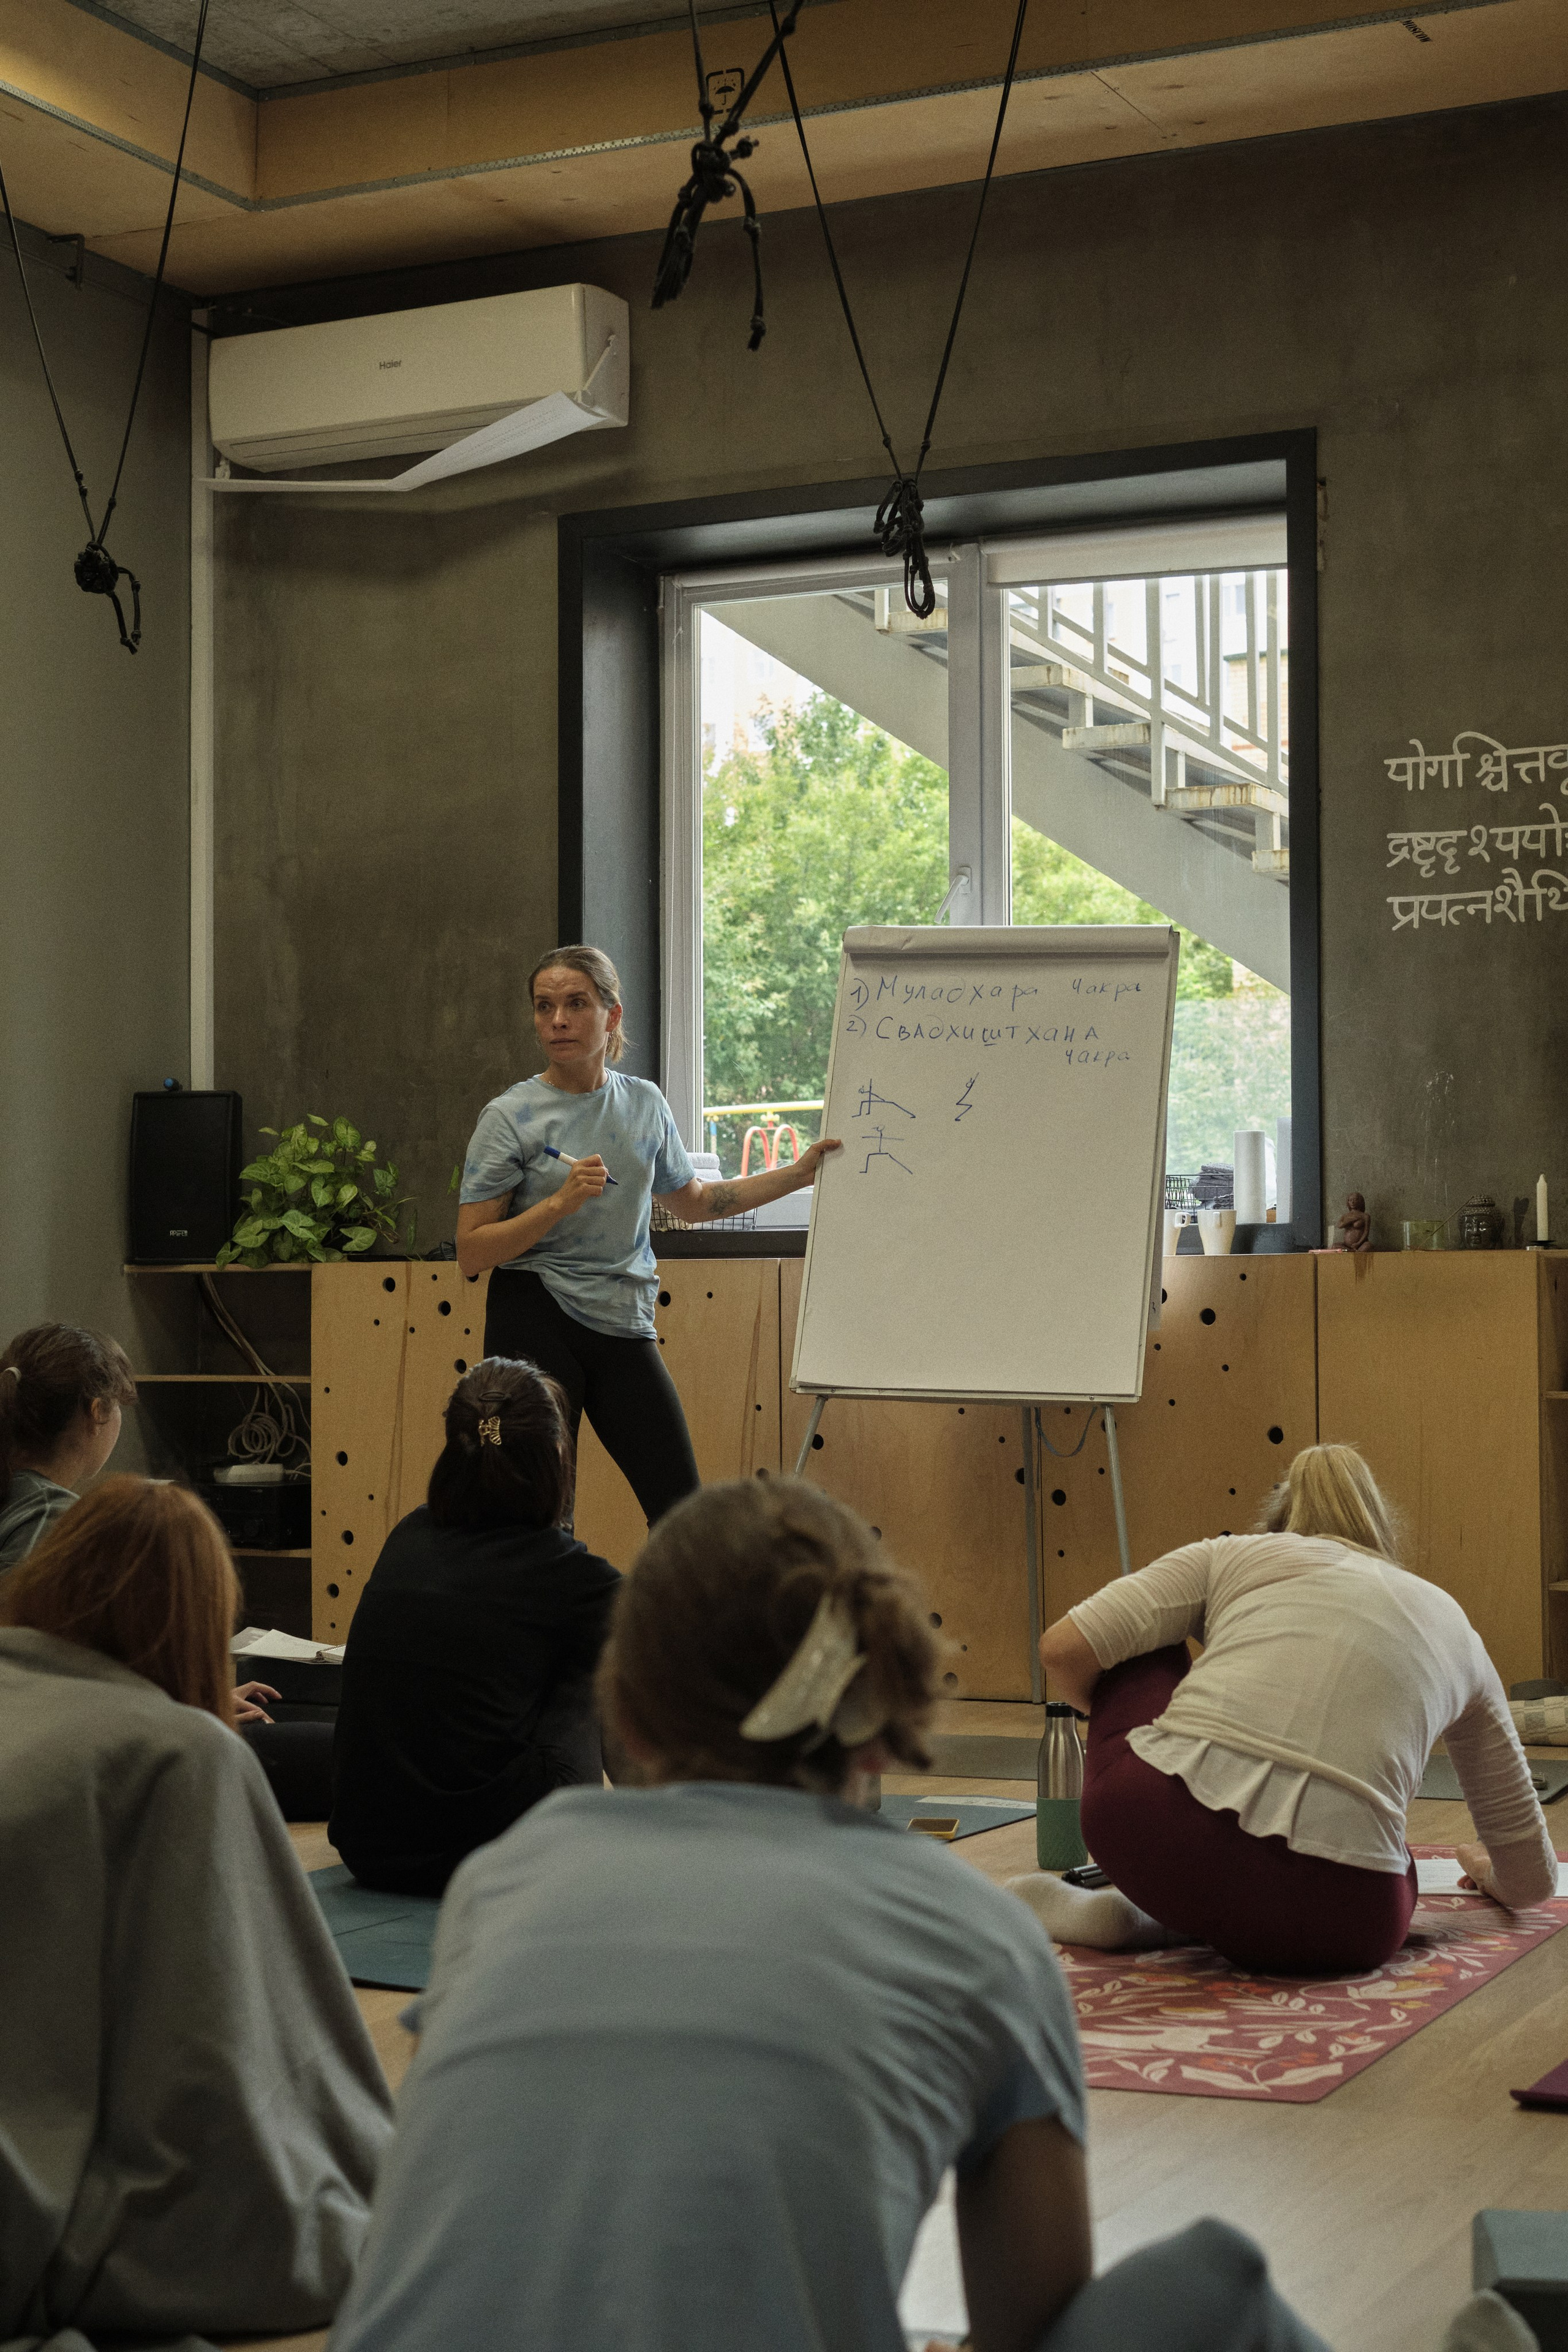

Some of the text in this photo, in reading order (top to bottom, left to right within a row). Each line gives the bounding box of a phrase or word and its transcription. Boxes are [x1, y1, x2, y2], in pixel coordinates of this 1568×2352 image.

[1400, 20, 1433, 42] MOSCOW
[379, 359, 402, 370] Haier
[850, 978, 869, 1011] 1)
[846, 1015, 867, 1037] 2)
